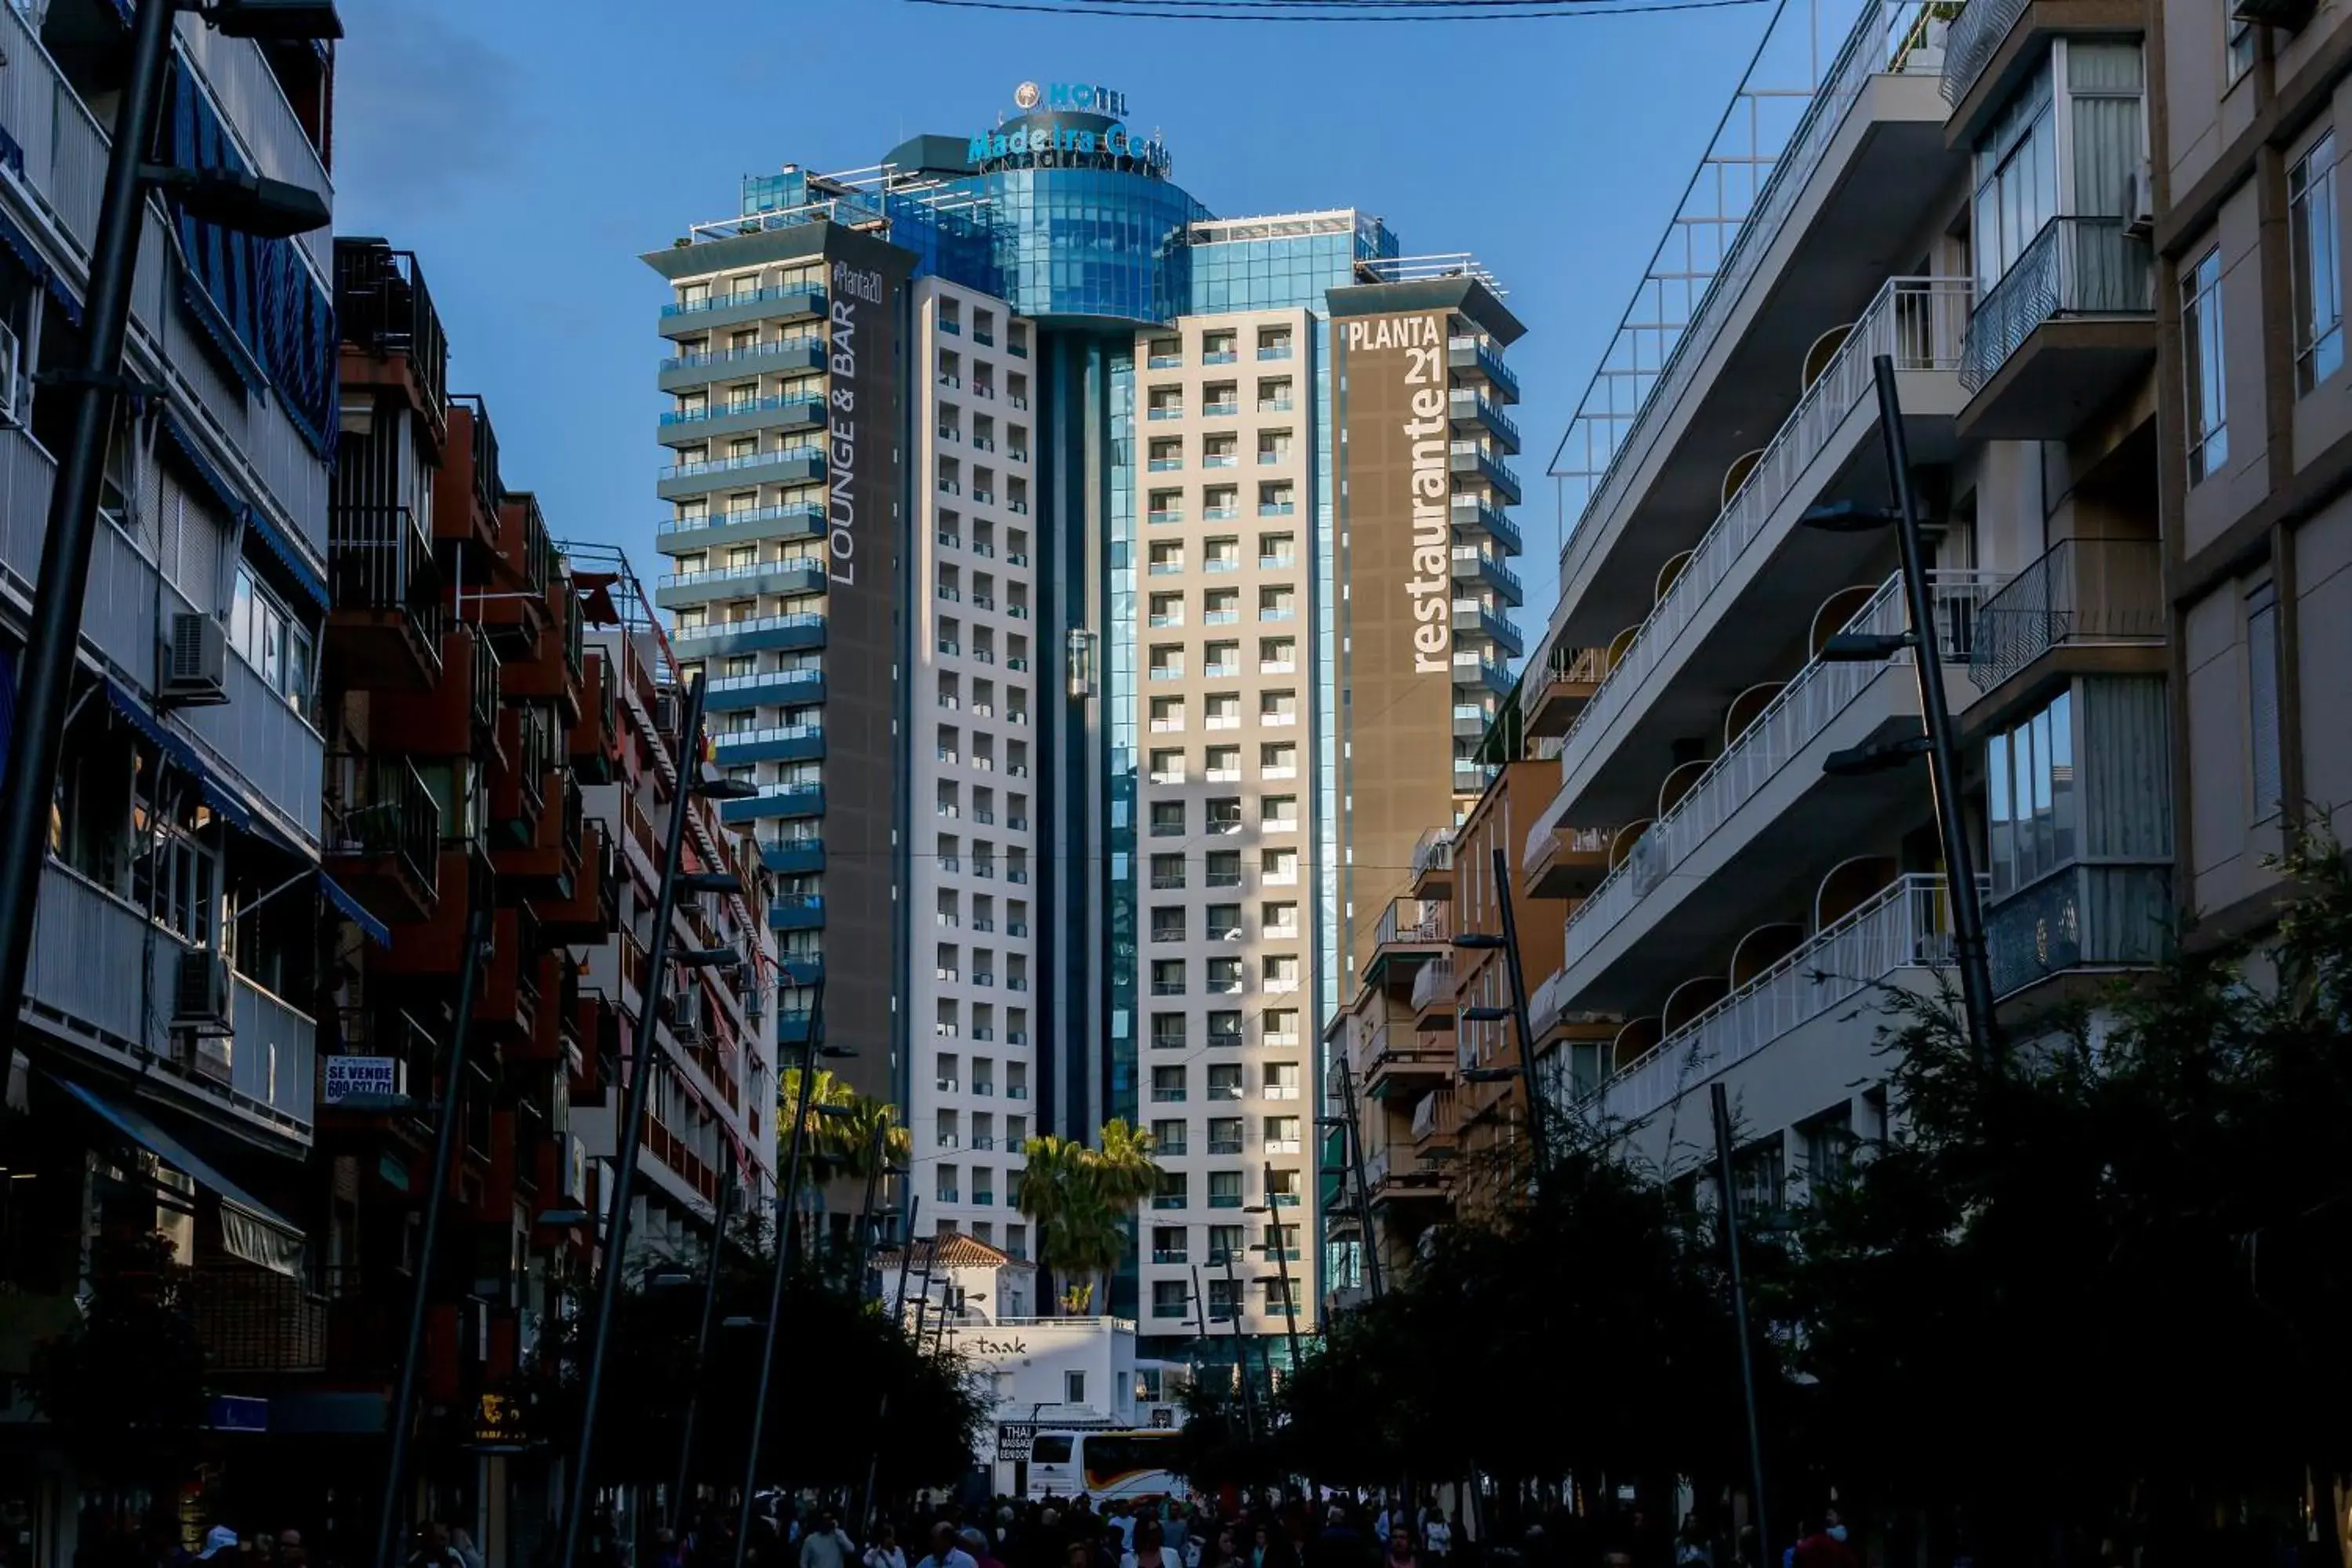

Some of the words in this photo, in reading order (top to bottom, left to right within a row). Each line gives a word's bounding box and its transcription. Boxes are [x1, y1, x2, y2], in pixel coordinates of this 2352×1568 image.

[1048, 82, 1130, 117] HOTEL
[967, 120, 1095, 164] Madeira
[832, 300, 855, 379] BAR
[1349, 316, 1440, 351] PLANTA
[1404, 346, 1441, 384] 21
[831, 389, 854, 412] &
[830, 416, 854, 586] LOUNGE
[1403, 389, 1448, 673] restaurante
[329, 1066, 345, 1080] SE
[348, 1067, 391, 1080] VENDE
[977, 1336, 1026, 1354] taak
[1001, 1438, 1031, 1449] MASSAG
[1004, 1426, 1032, 1439] THAI
[1000, 1449, 1030, 1459] BENIDOR
